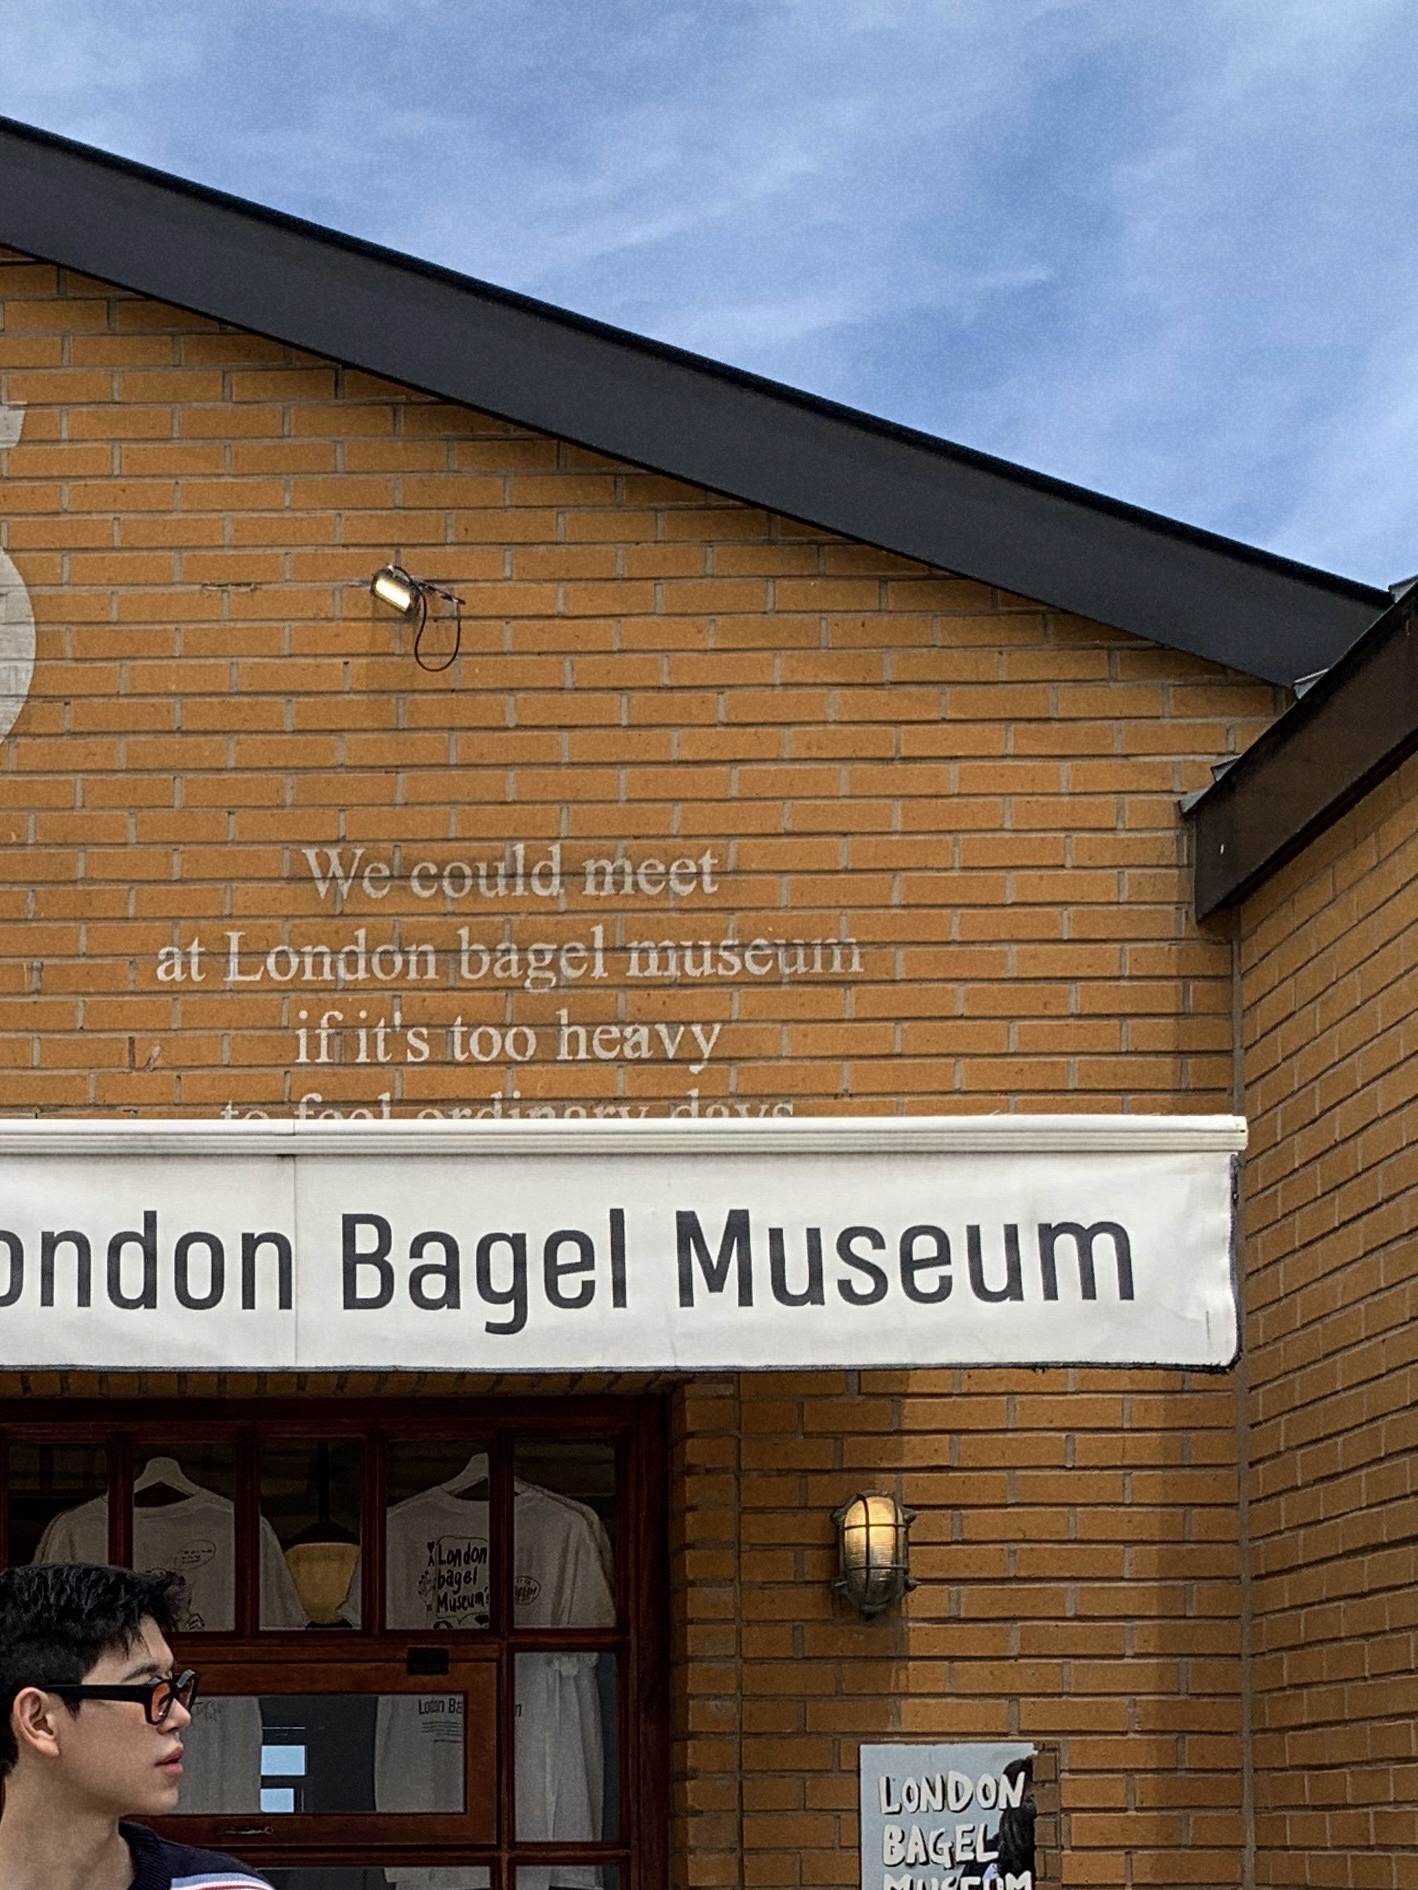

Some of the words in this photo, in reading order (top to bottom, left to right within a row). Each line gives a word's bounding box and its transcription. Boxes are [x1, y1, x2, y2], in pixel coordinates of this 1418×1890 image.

[302, 848, 391, 899] We
[410, 843, 565, 898] could
[582, 848, 719, 896] meet
[156, 936, 206, 982] at
[223, 928, 440, 983] London
[457, 924, 609, 993] bagel
[625, 938, 864, 978] museum
[295, 1010, 344, 1063] if
[355, 1010, 431, 1062] it's
[450, 1015, 537, 1062] too
[556, 1008, 722, 1074] heavy
[341, 1208, 628, 1335] Bagel
[675, 1208, 1135, 1308] Museum
[438, 1542, 488, 1567] London
[438, 1566, 478, 1595] bagel
[879, 1770, 1026, 1815] LONDON
[883, 1823, 1000, 1869] BAGEL
